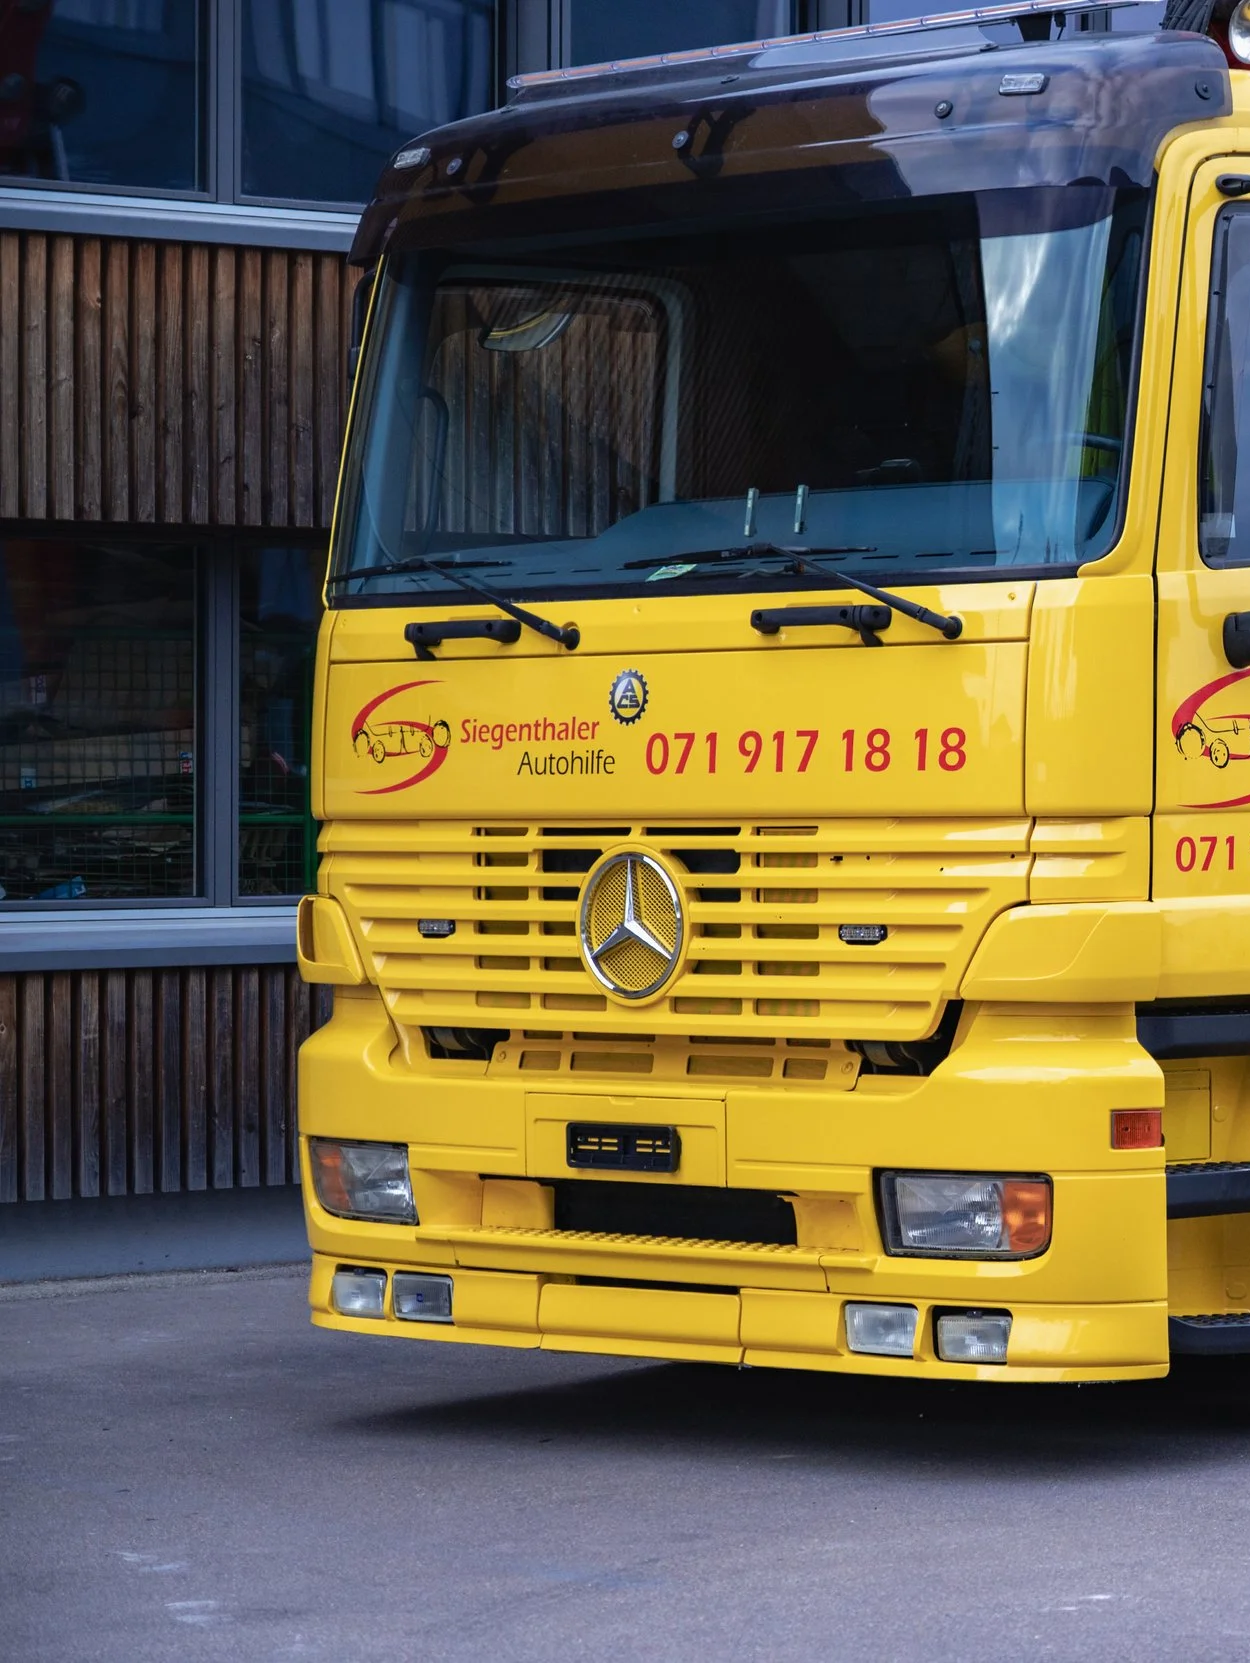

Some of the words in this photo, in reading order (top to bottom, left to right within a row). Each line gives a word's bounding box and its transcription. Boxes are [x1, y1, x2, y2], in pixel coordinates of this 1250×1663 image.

[460, 716, 600, 751] Siegenthaler
[645, 732, 719, 775] 071
[738, 729, 820, 773] 917
[842, 728, 892, 772] 18
[914, 727, 967, 772] 18
[517, 750, 615, 776] Autohilfe
[1175, 836, 1236, 873] 071
